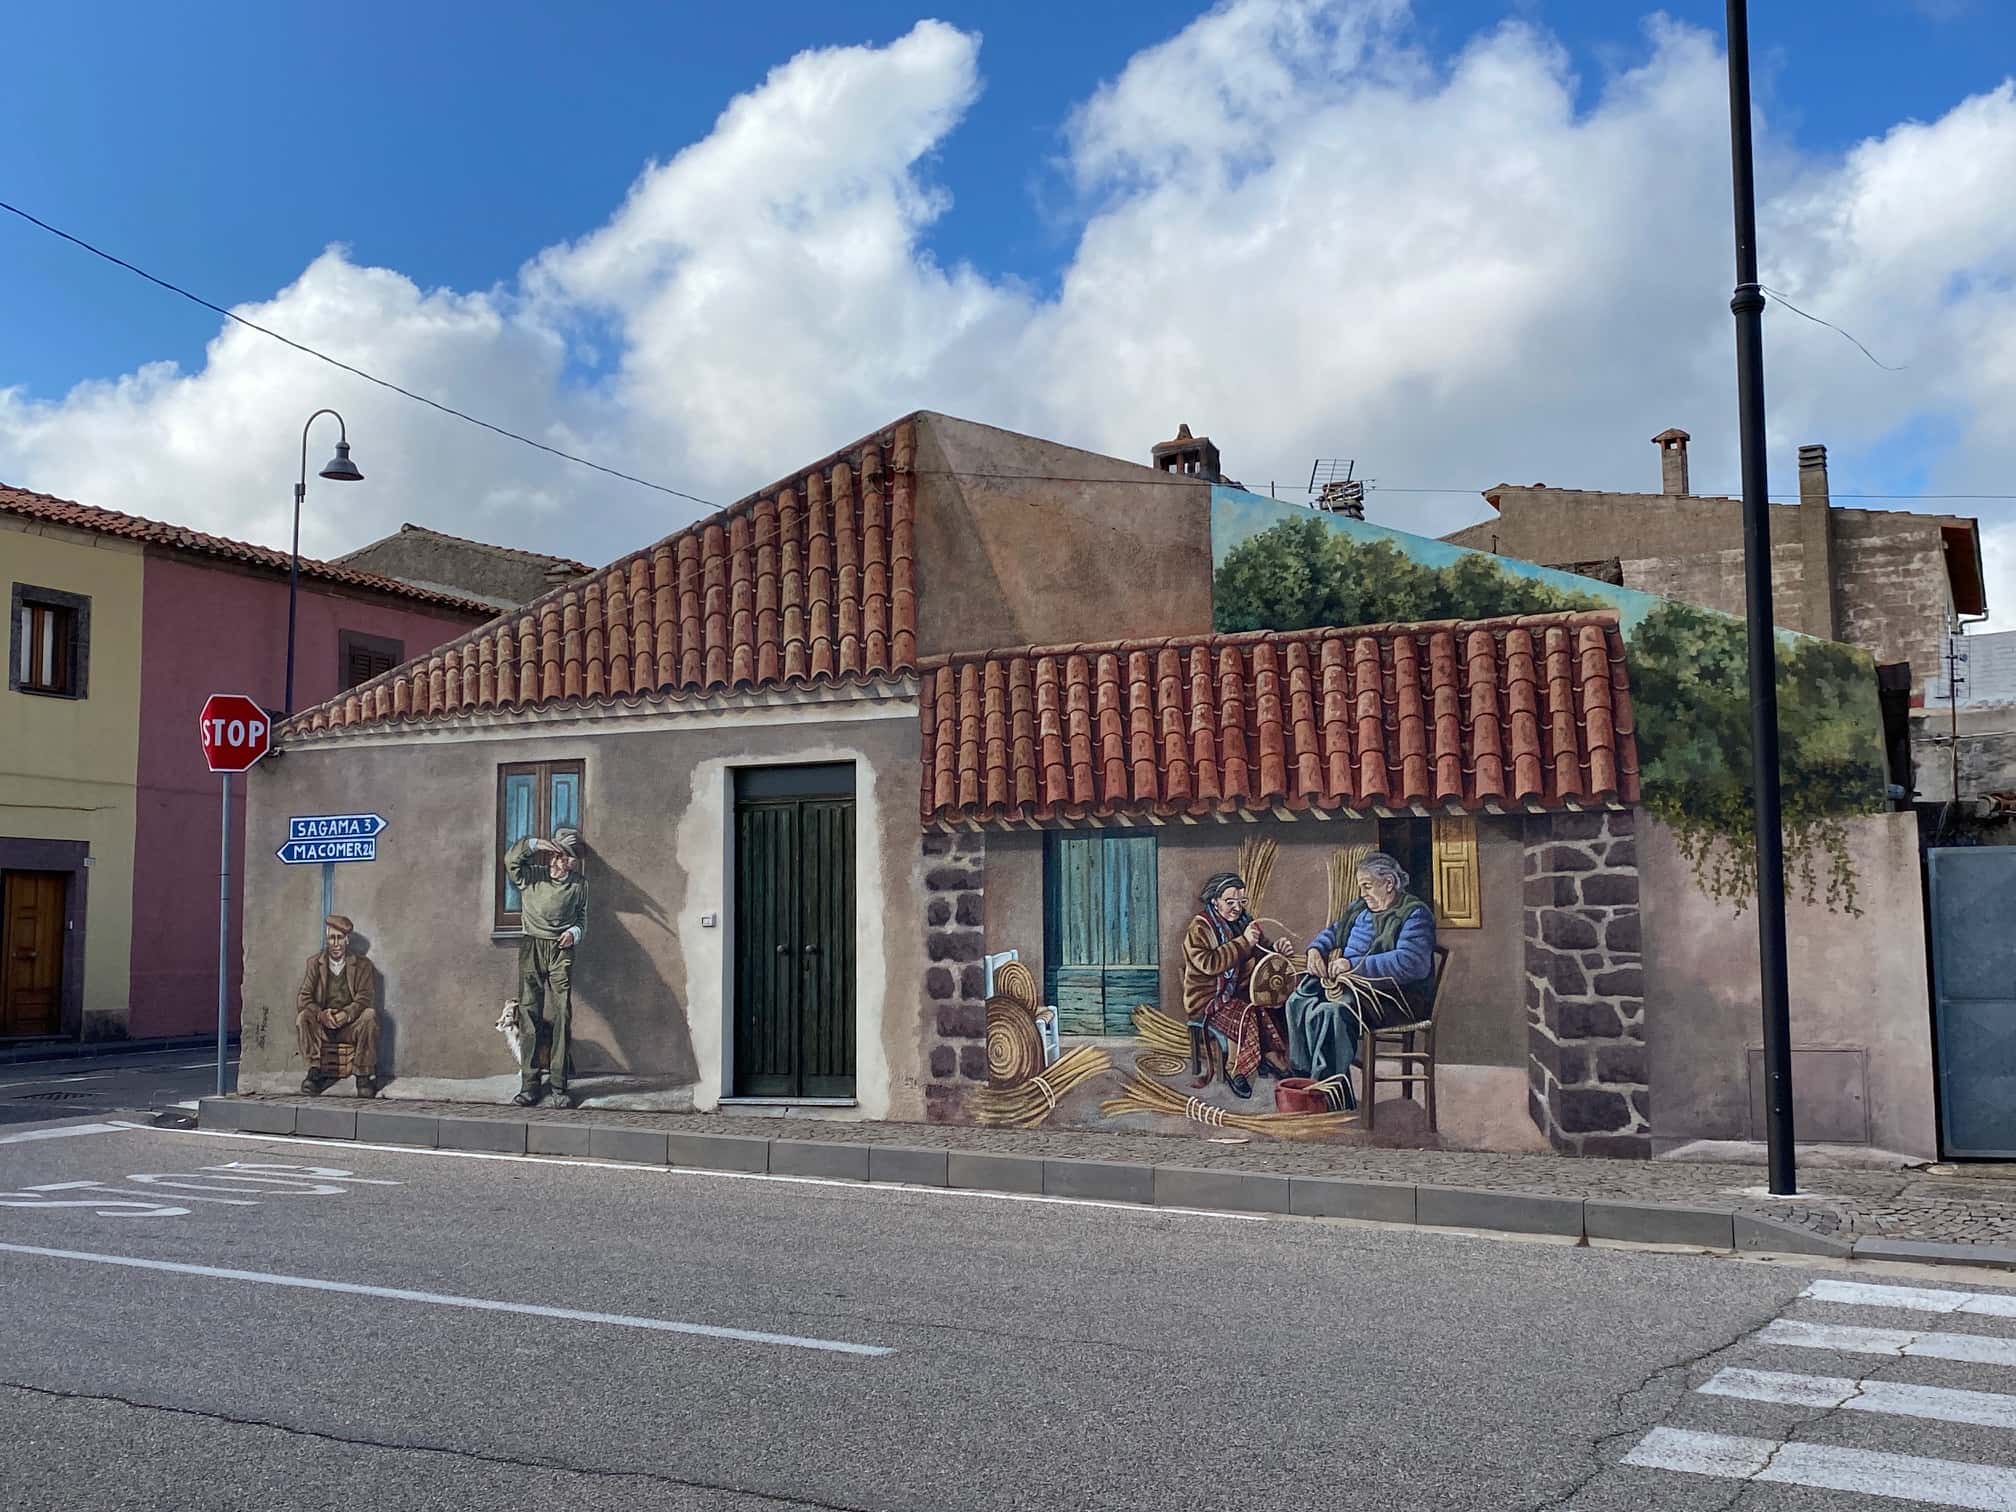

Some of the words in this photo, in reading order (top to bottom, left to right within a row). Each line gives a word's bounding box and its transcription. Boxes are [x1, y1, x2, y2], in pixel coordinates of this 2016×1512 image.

[203, 718, 265, 748] STOP
[297, 819, 360, 837] SAGAMA
[364, 818, 372, 832] 3
[293, 842, 362, 860] MACOMER
